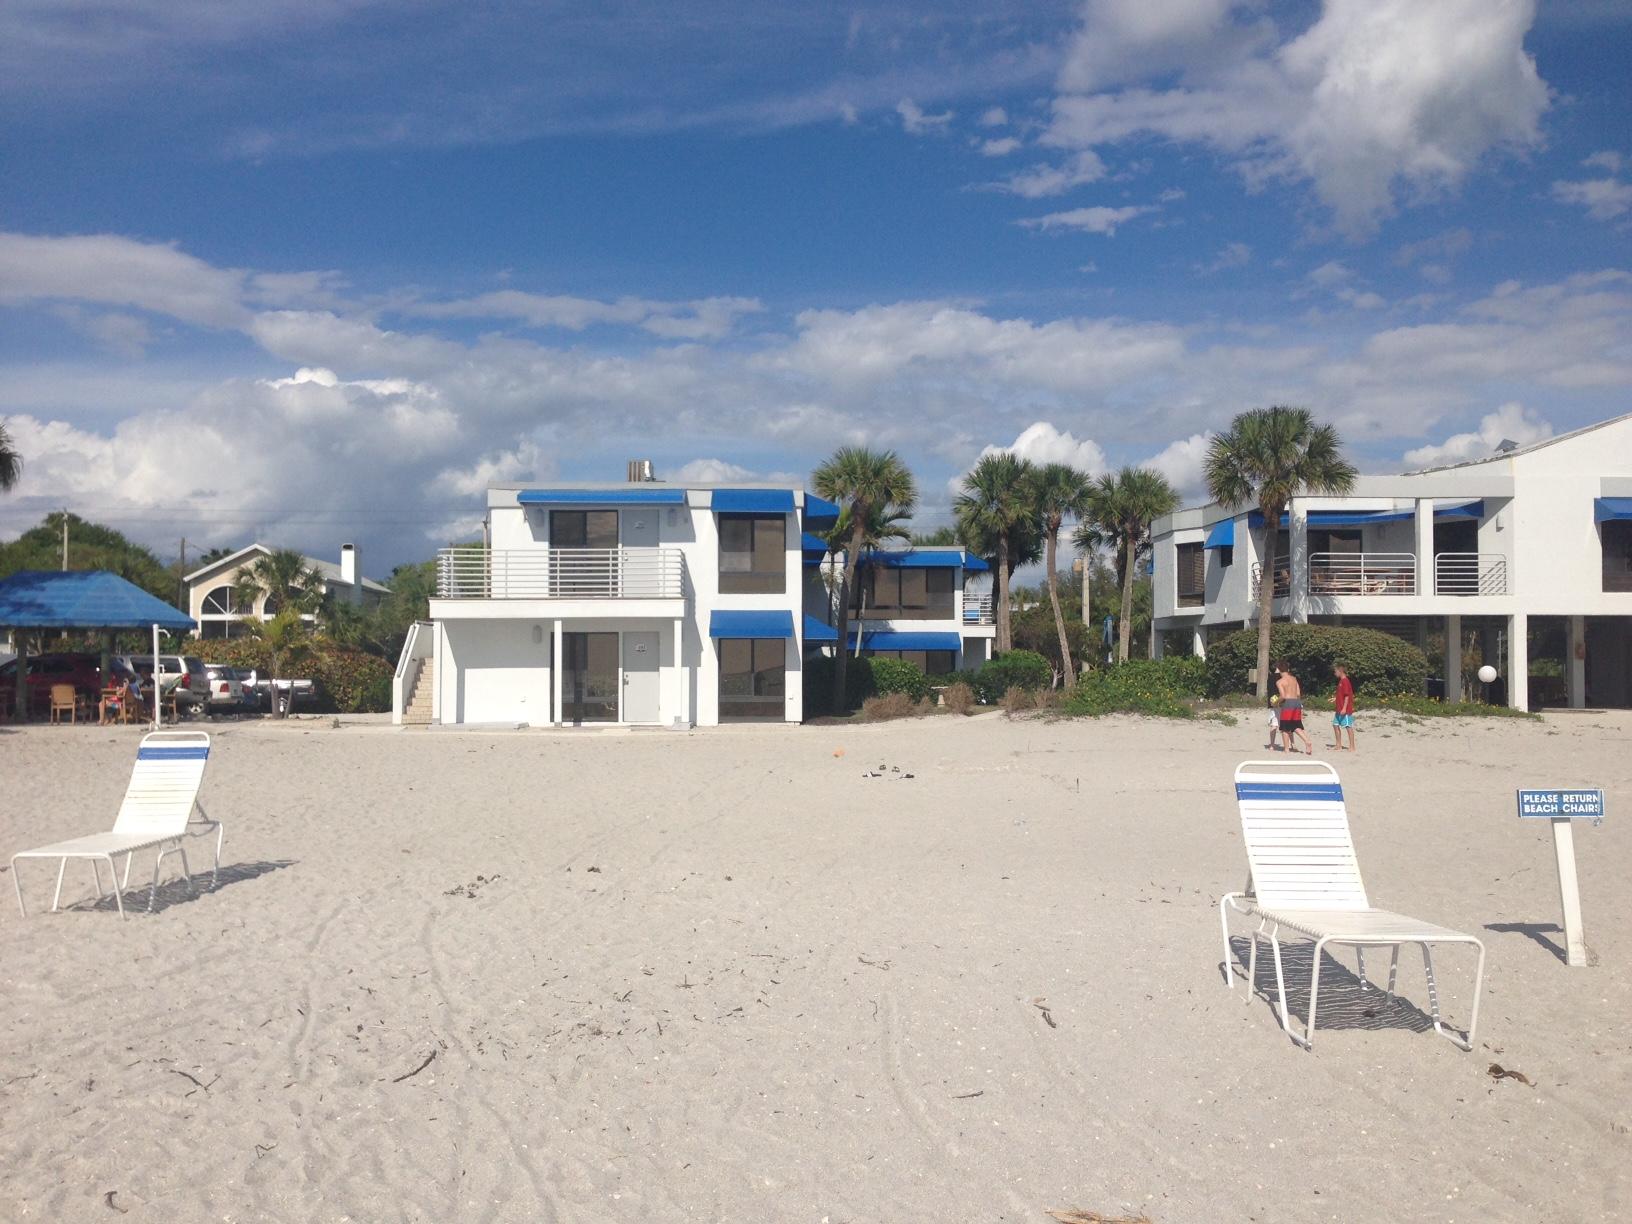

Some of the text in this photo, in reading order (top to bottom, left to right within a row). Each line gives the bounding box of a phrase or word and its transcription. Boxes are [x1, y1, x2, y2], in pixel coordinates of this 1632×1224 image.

[1523, 794, 1599, 803] PLEASE RETURN
[1524, 804, 1558, 813] BEACH
